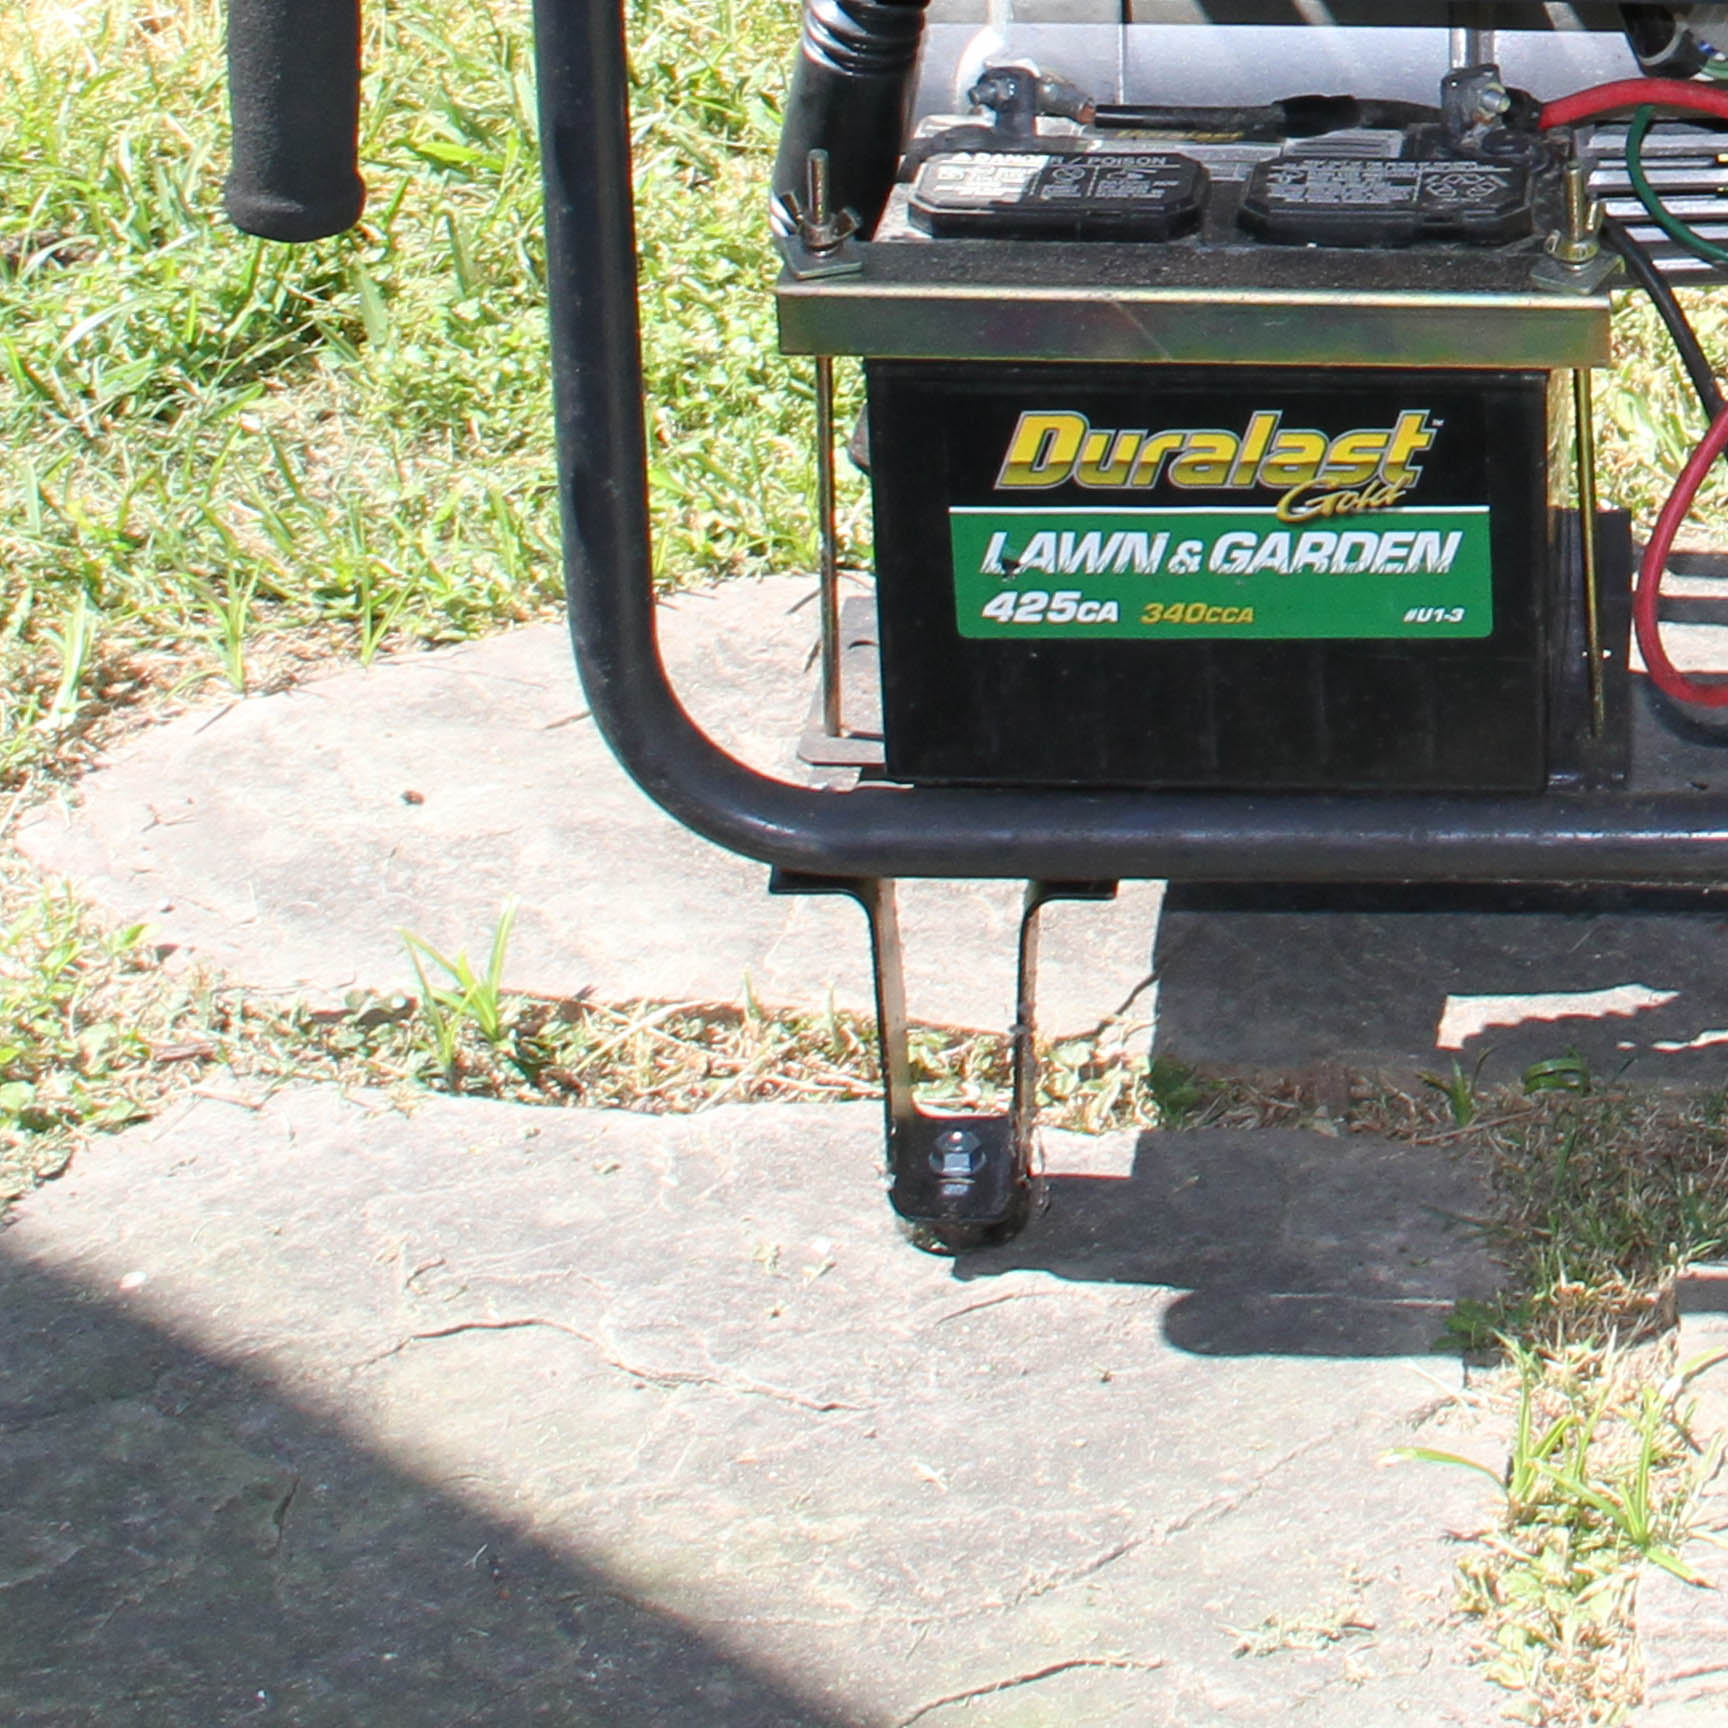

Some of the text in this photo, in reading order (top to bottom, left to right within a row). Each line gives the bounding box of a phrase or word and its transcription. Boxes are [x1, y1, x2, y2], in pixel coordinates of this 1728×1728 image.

[1084, 155, 1168, 166] POISON
[993, 409, 1436, 490] Duralast
[1276, 472, 1413, 523] Gold
[979, 530, 1168, 577] LAWN
[1206, 530, 1463, 576] GARDEN
